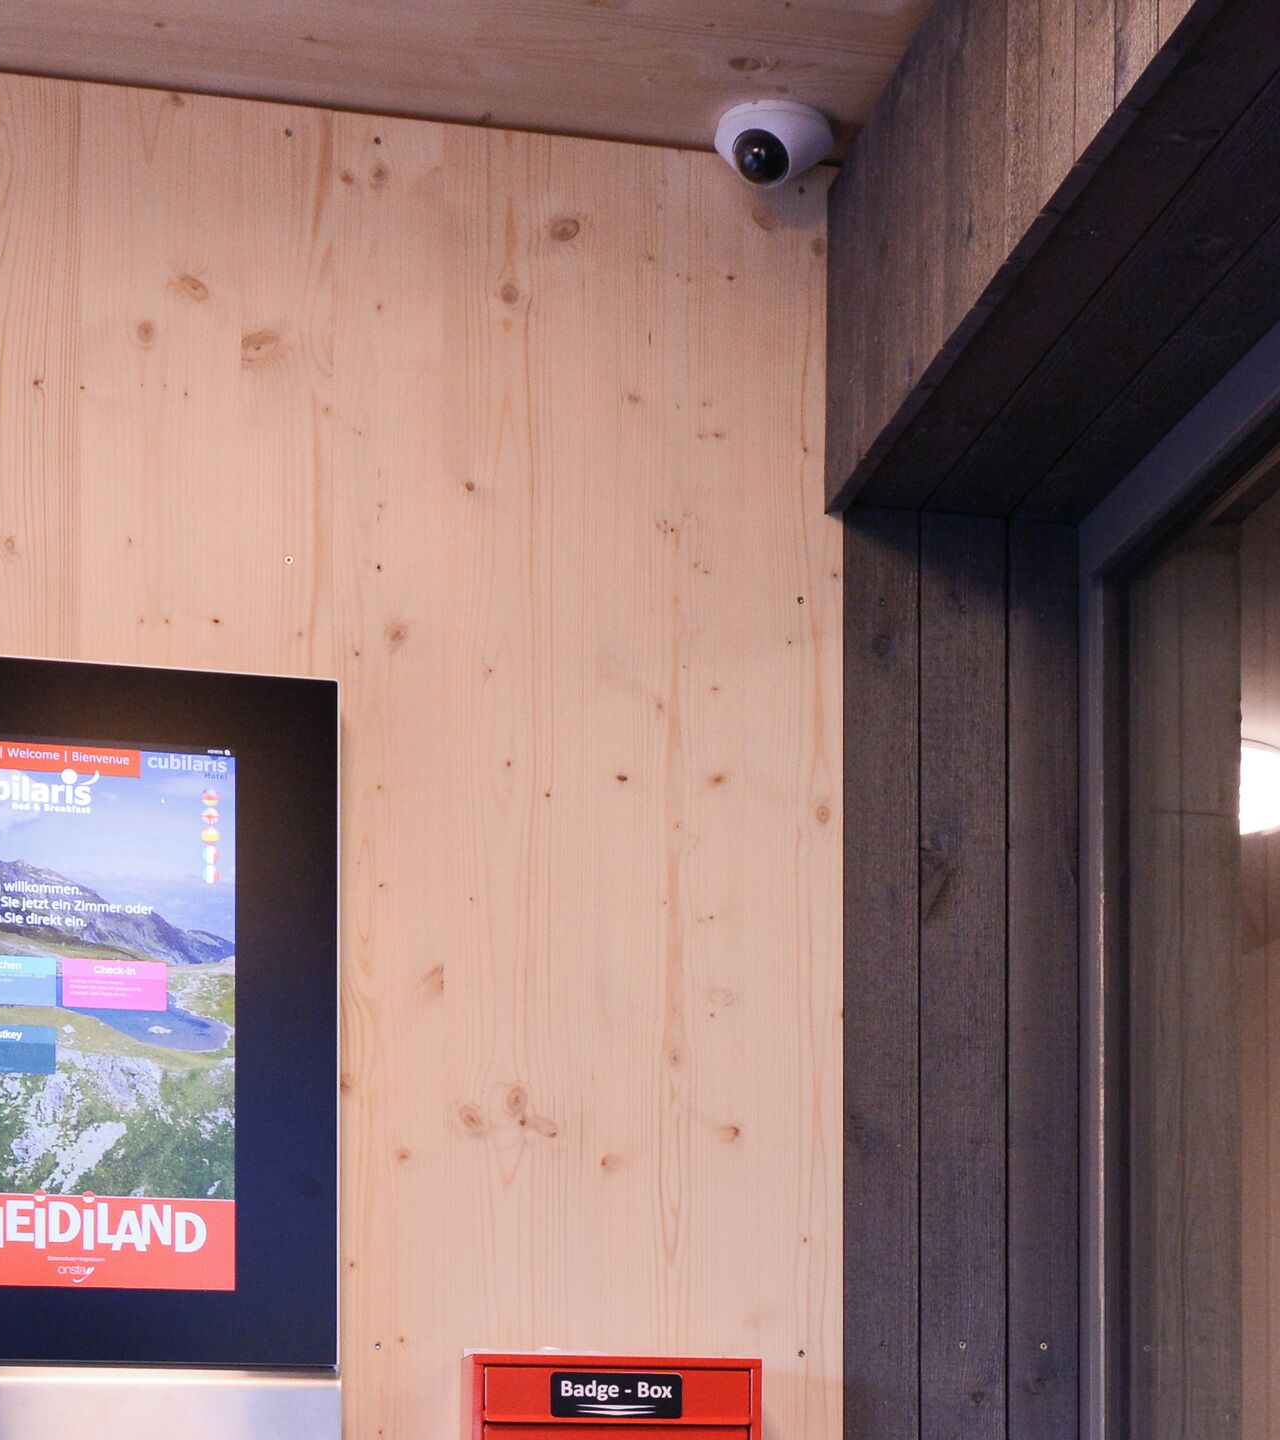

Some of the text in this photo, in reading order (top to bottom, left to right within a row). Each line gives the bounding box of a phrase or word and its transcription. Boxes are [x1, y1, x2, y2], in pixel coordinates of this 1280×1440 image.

[7, 748, 60, 760] Welcome
[72, 752, 130, 765] Bienvenue
[147, 754, 228, 772] cubilaris
[12, 802, 30, 810] Bed
[44, 804, 91, 814] Breakfast
[4, 880, 83, 896] willkommen.
[1, 896, 20, 908] Sie
[20, 896, 50, 911] jetzt
[52, 898, 72, 910] ein
[74, 900, 122, 913] Zimmer
[125, 902, 154, 915] oder
[4, 912, 24, 924] Sie
[26, 912, 64, 926] direkt
[64, 915, 88, 928] ein.
[58, 1266, 95, 1283] onstay
[560, 1380, 619, 1400] Badge
[638, 1382, 672, 1398] Box
